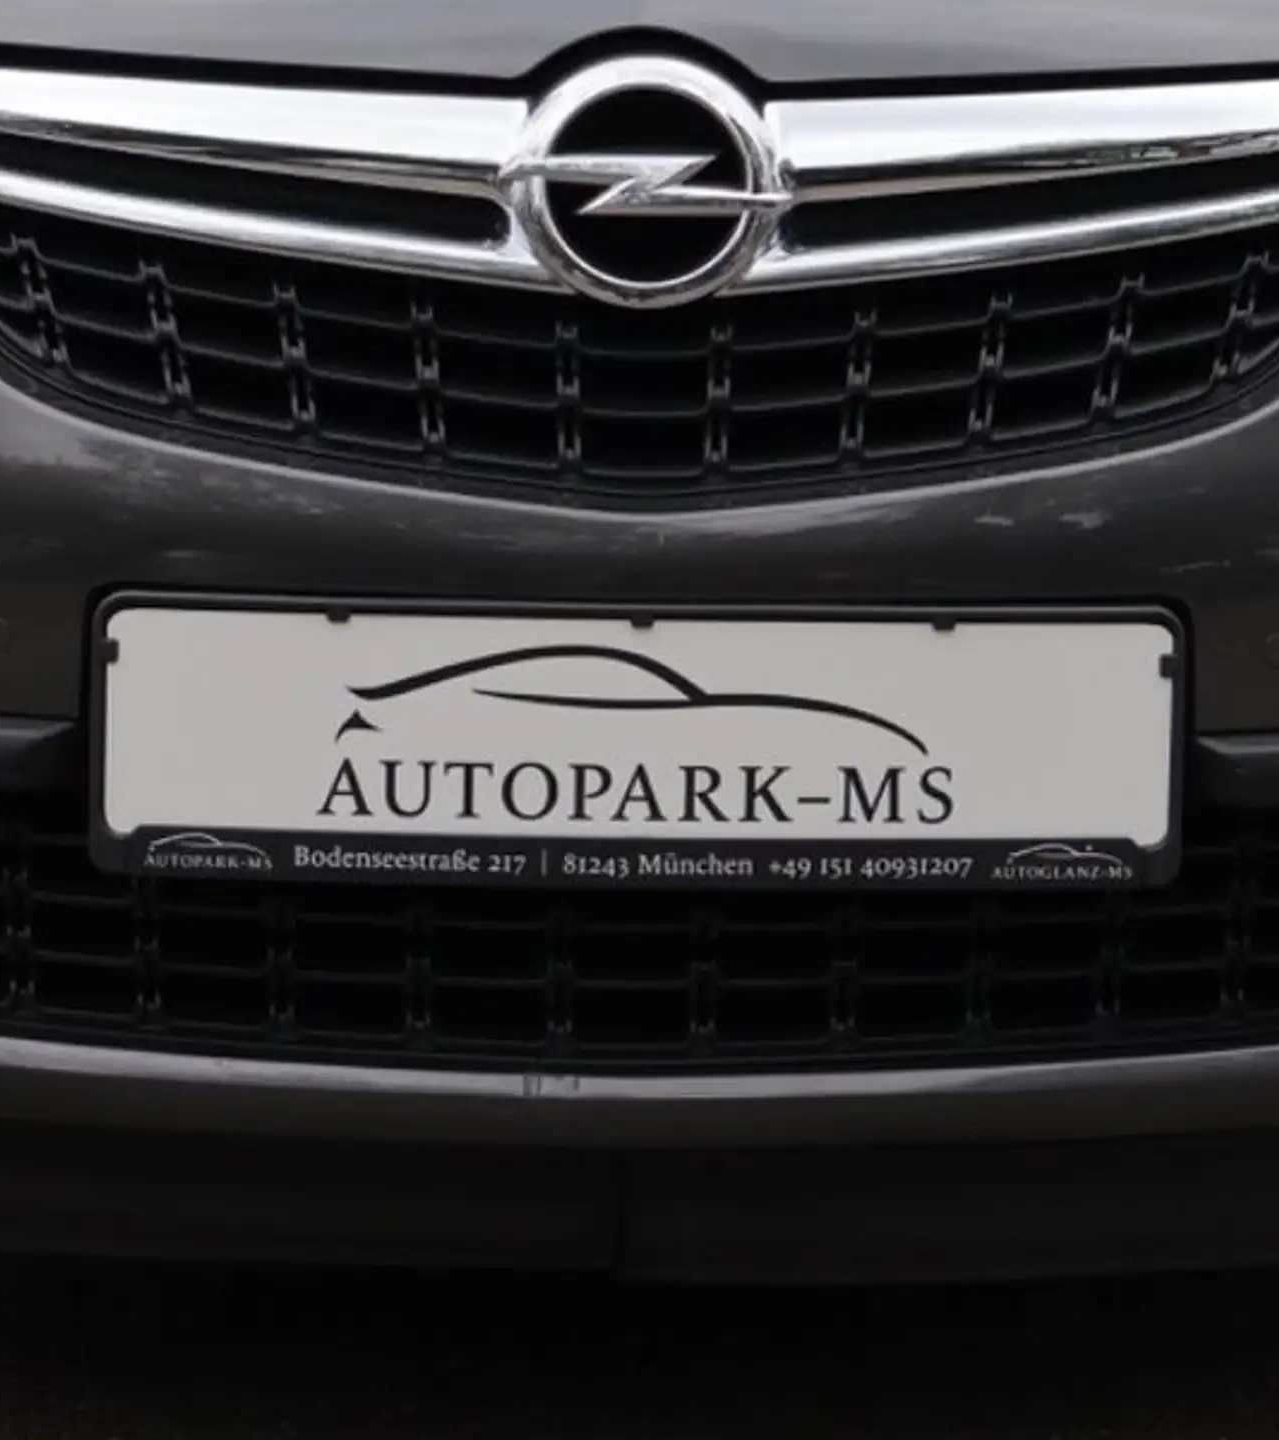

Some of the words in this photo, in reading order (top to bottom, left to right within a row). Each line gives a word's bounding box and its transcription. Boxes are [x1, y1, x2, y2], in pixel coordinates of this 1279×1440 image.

[315, 757, 955, 826] AUTOPARK-MS
[293, 845, 479, 872] Bodenseestraße
[487, 853, 528, 876] 217
[562, 851, 630, 878] 81243
[637, 851, 754, 877] München
[769, 856, 812, 879] +49
[819, 857, 852, 879] 151
[860, 856, 975, 879] 40931207
